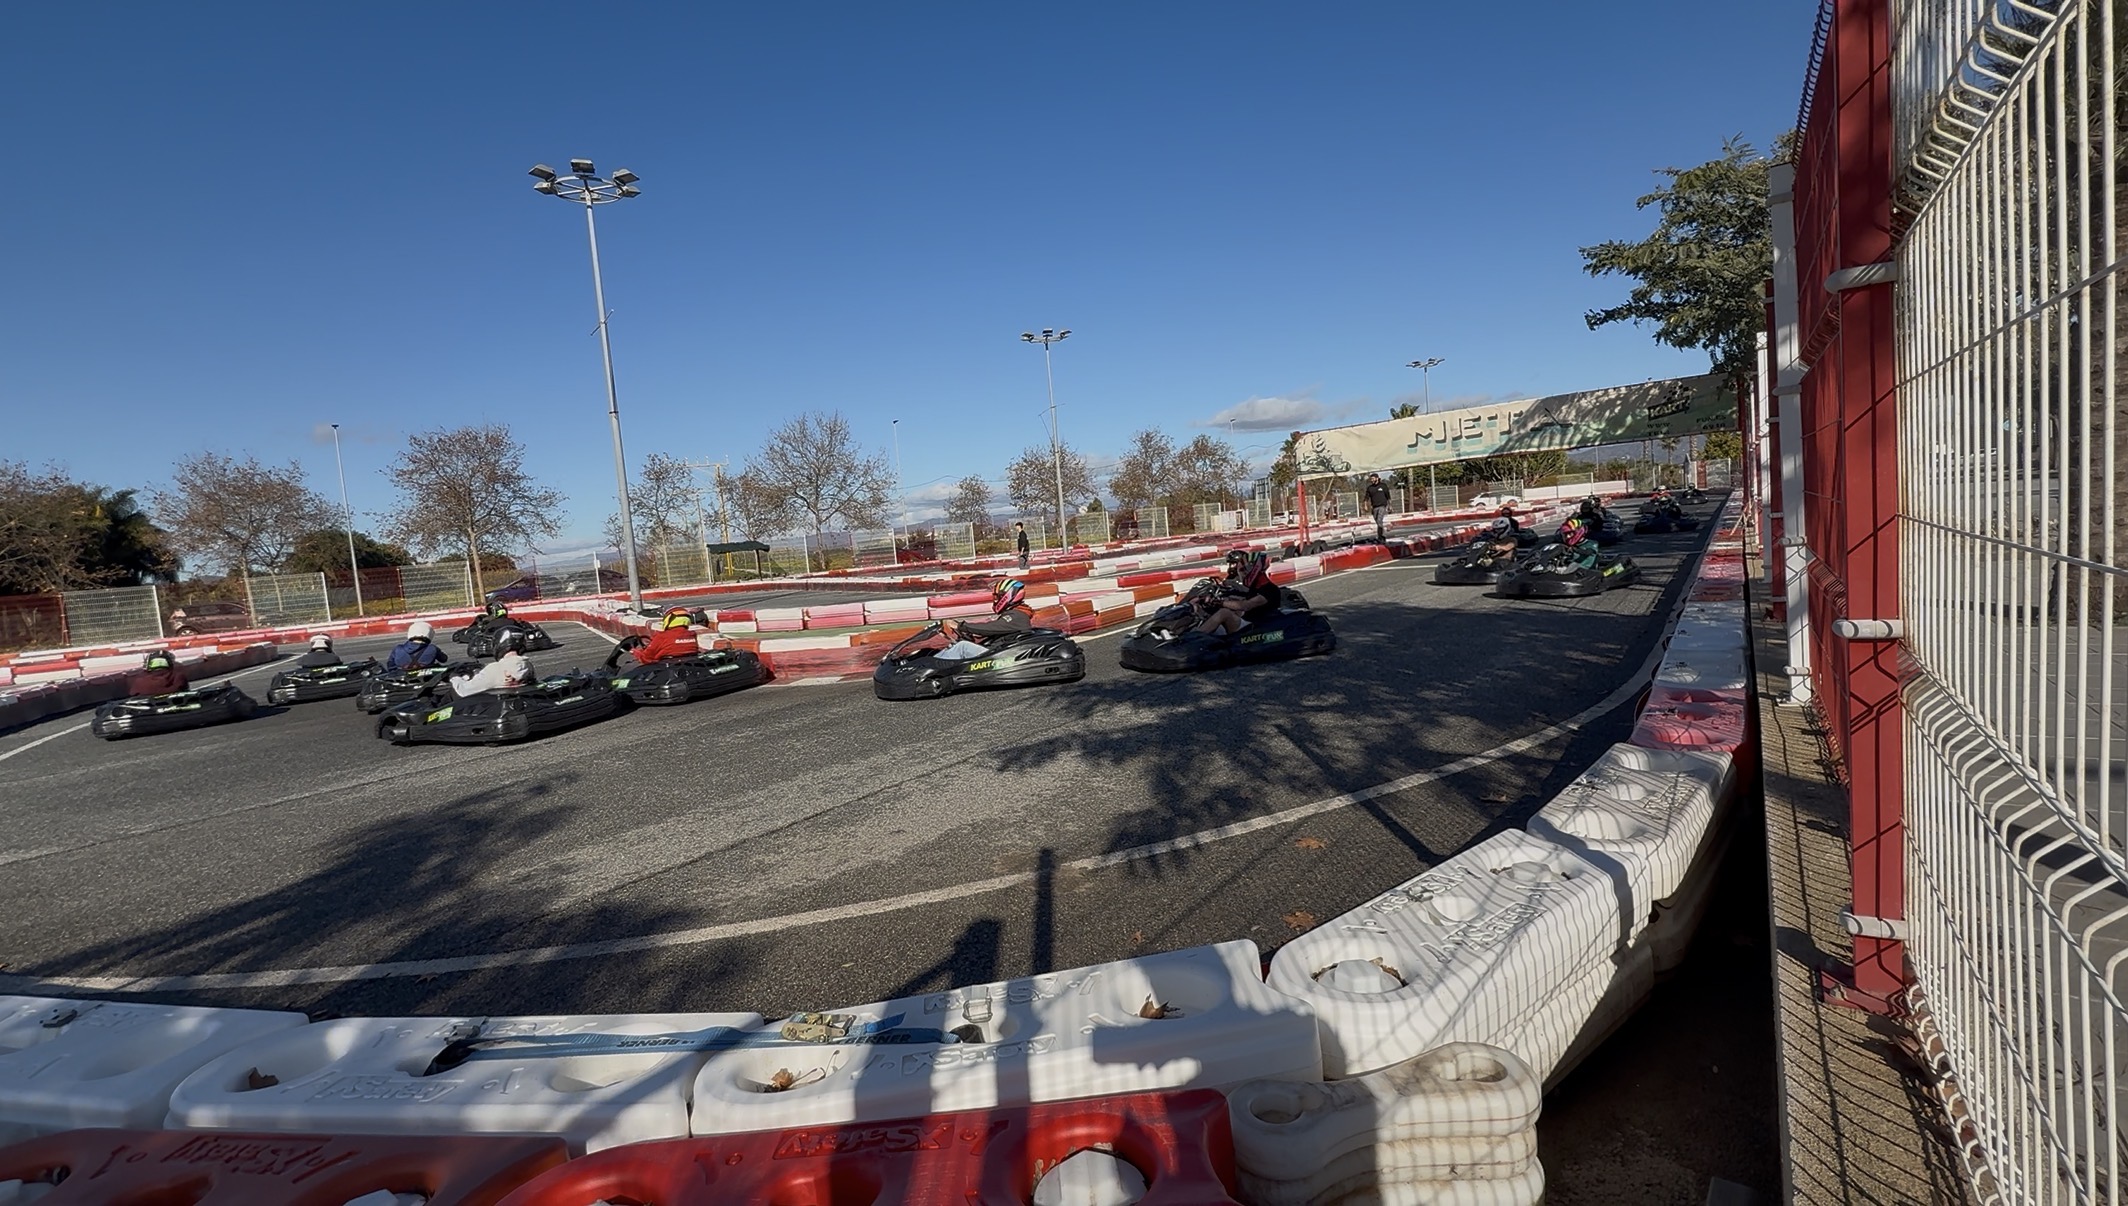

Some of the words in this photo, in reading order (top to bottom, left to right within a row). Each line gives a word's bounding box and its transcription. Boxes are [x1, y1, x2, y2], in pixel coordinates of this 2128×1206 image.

[1407, 403, 1574, 448] META
[1241, 634, 1261, 644] KART
[970, 660, 992, 671] KART
[617, 1038, 681, 1048] BERNER
